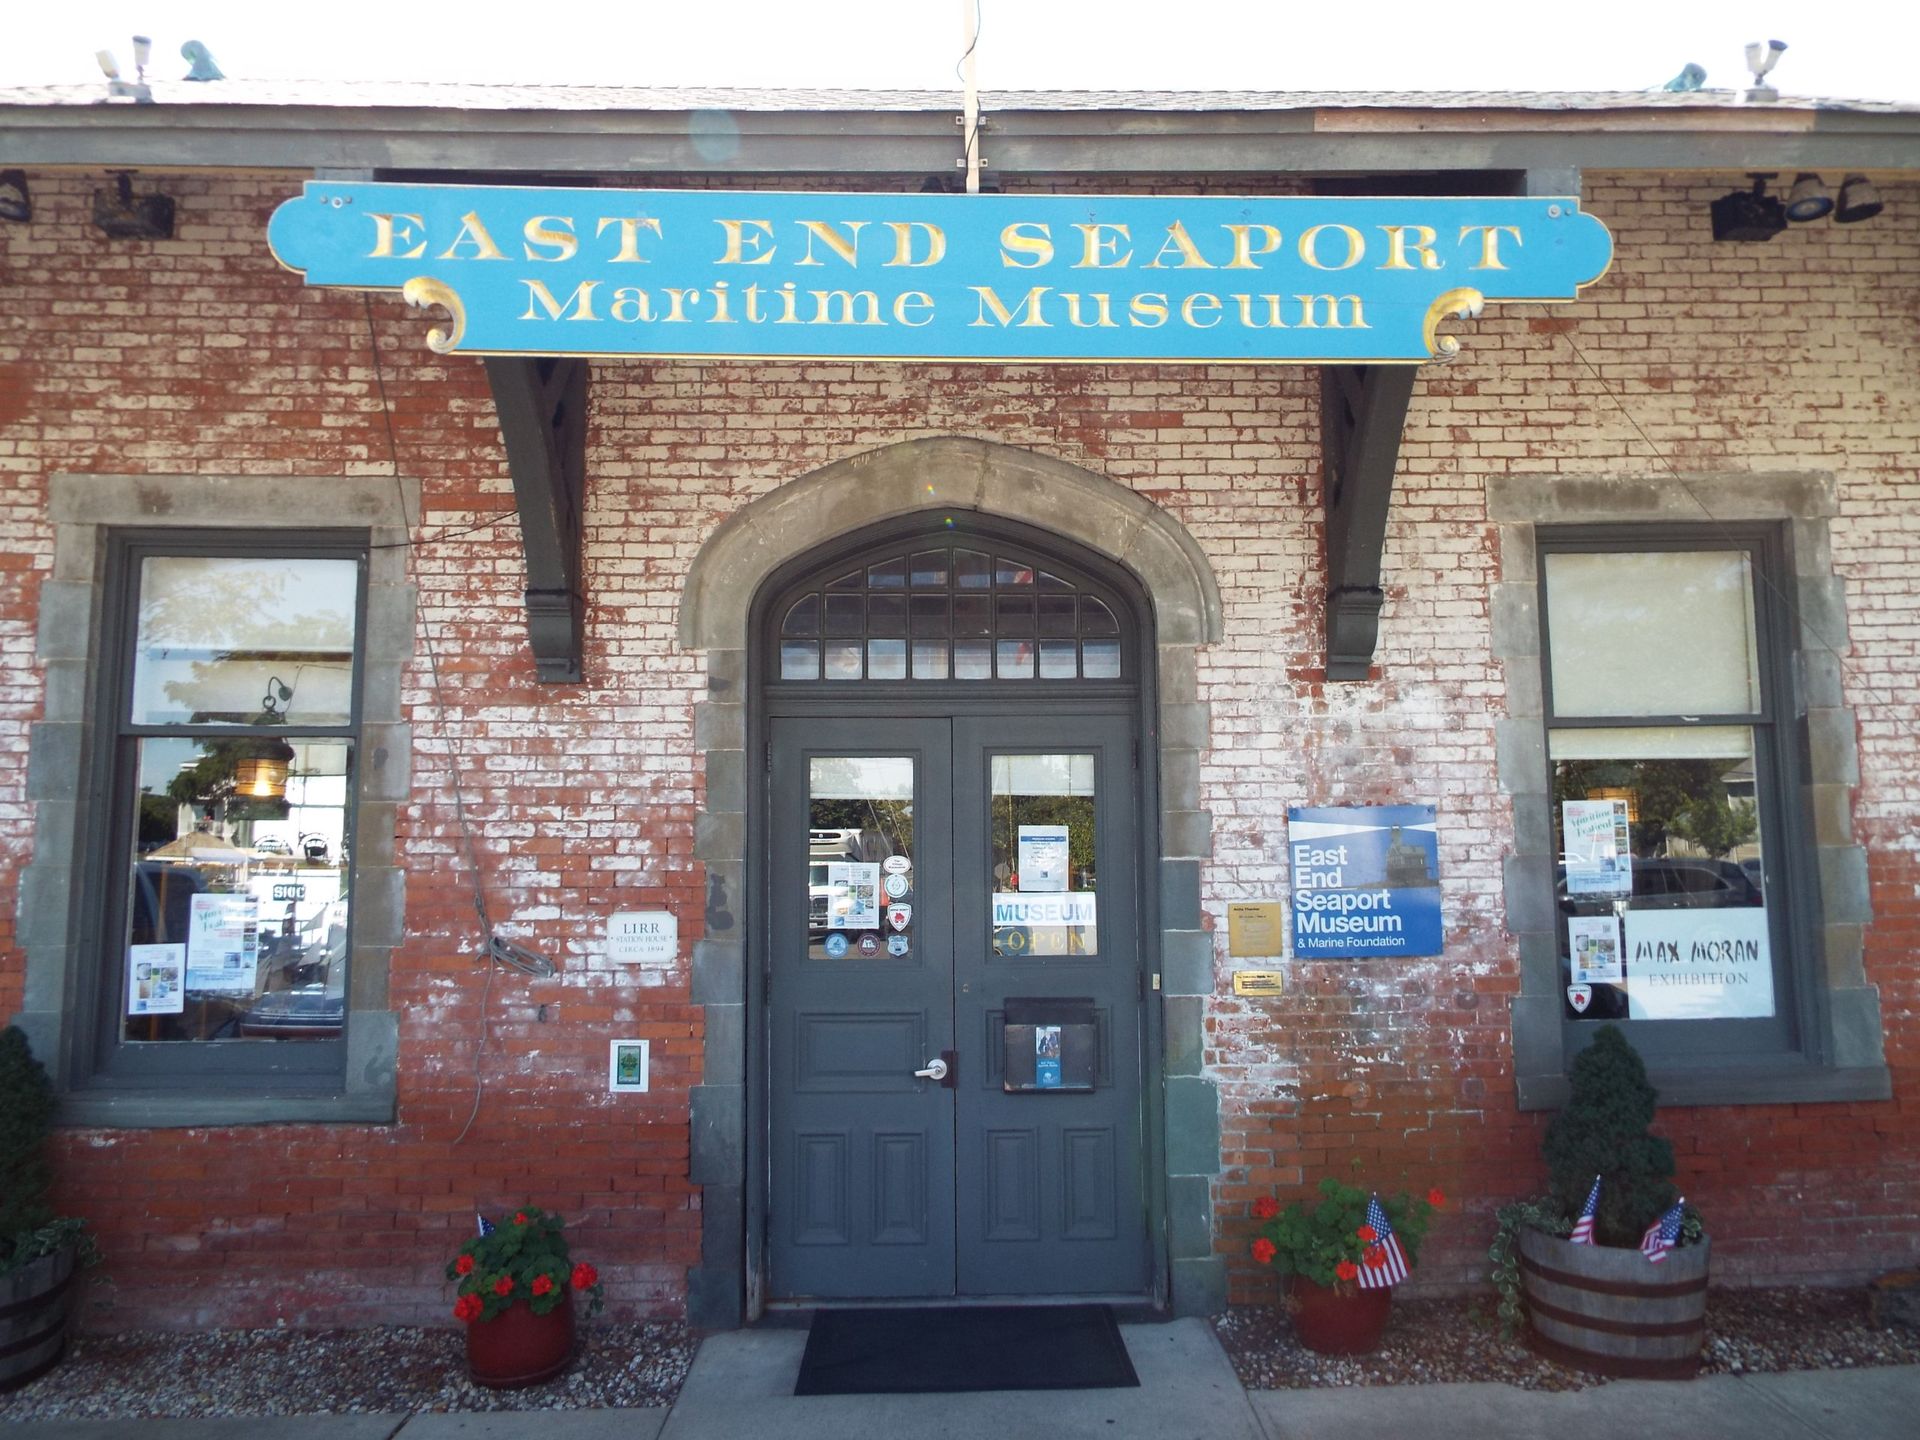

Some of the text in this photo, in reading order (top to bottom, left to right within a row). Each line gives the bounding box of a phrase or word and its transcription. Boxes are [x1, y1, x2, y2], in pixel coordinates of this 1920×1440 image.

[363, 210, 1523, 271] EAST END SEAPORT
[517, 278, 1373, 330] Maritime Museum
[1294, 845, 1348, 866] East
[1295, 866, 1342, 888] End
[996, 903, 1093, 922] MUSEUM
[1295, 889, 1391, 915] Seaport
[624, 923, 659, 933] LIRR
[1297, 911, 1402, 934] Museum
[1007, 930, 1085, 953] OPEN
[1297, 935, 1406, 949] & Marine Foundation
[1635, 939, 1759, 963] MAX MORAN
[1648, 971, 1750, 986] EXHIBITION
